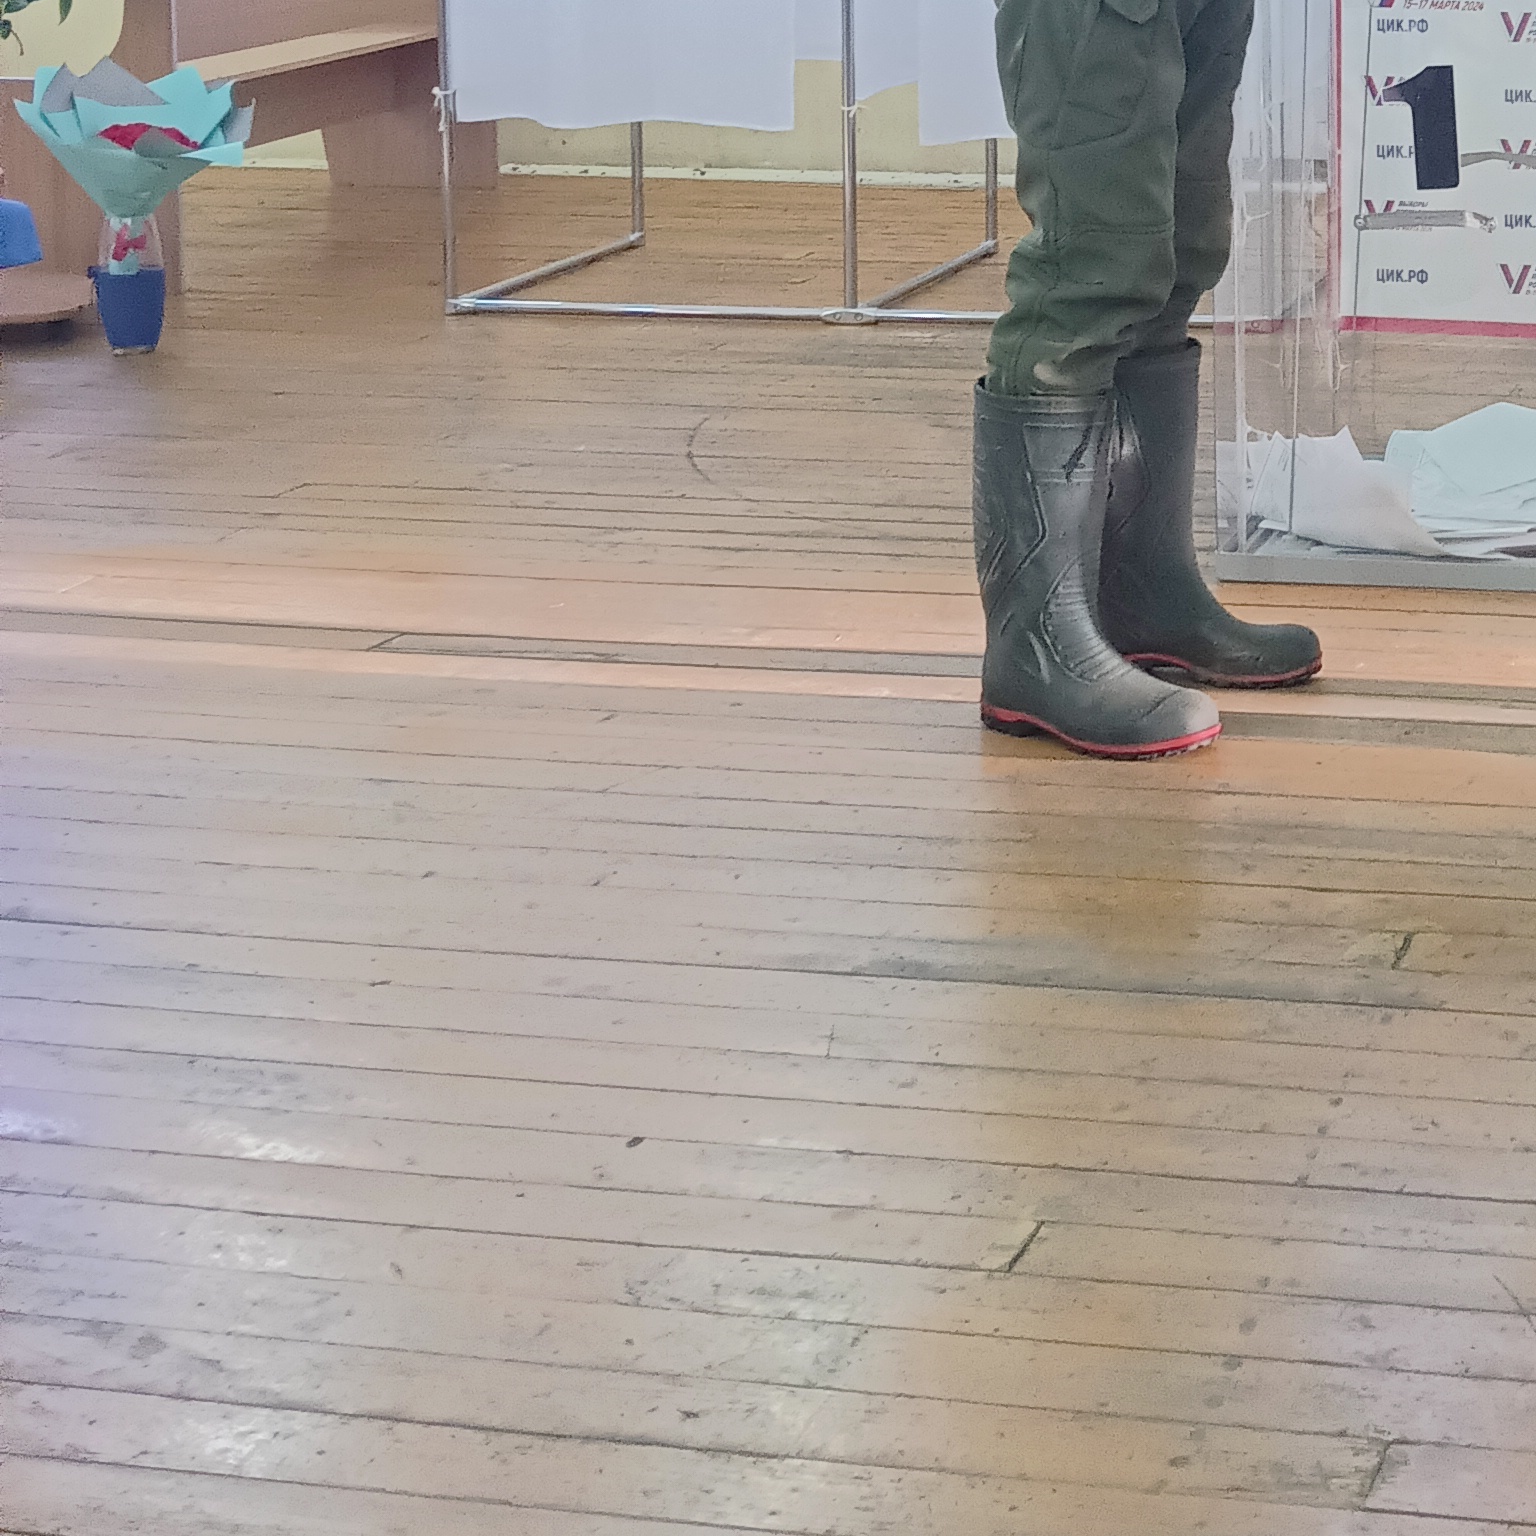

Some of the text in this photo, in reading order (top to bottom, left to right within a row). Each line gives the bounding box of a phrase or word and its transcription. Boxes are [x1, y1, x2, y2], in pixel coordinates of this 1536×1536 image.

[1429, 0, 1462, 11] МАРТА
[1462, 0, 1485, 12] 2024
[1376, 18, 1429, 35] ЦИК.РФ
[1382, 65, 1459, 191] 1
[1376, 144, 1415, 160] ЦИК.Р
[1376, 268, 1429, 285] ЦИК.РФ
